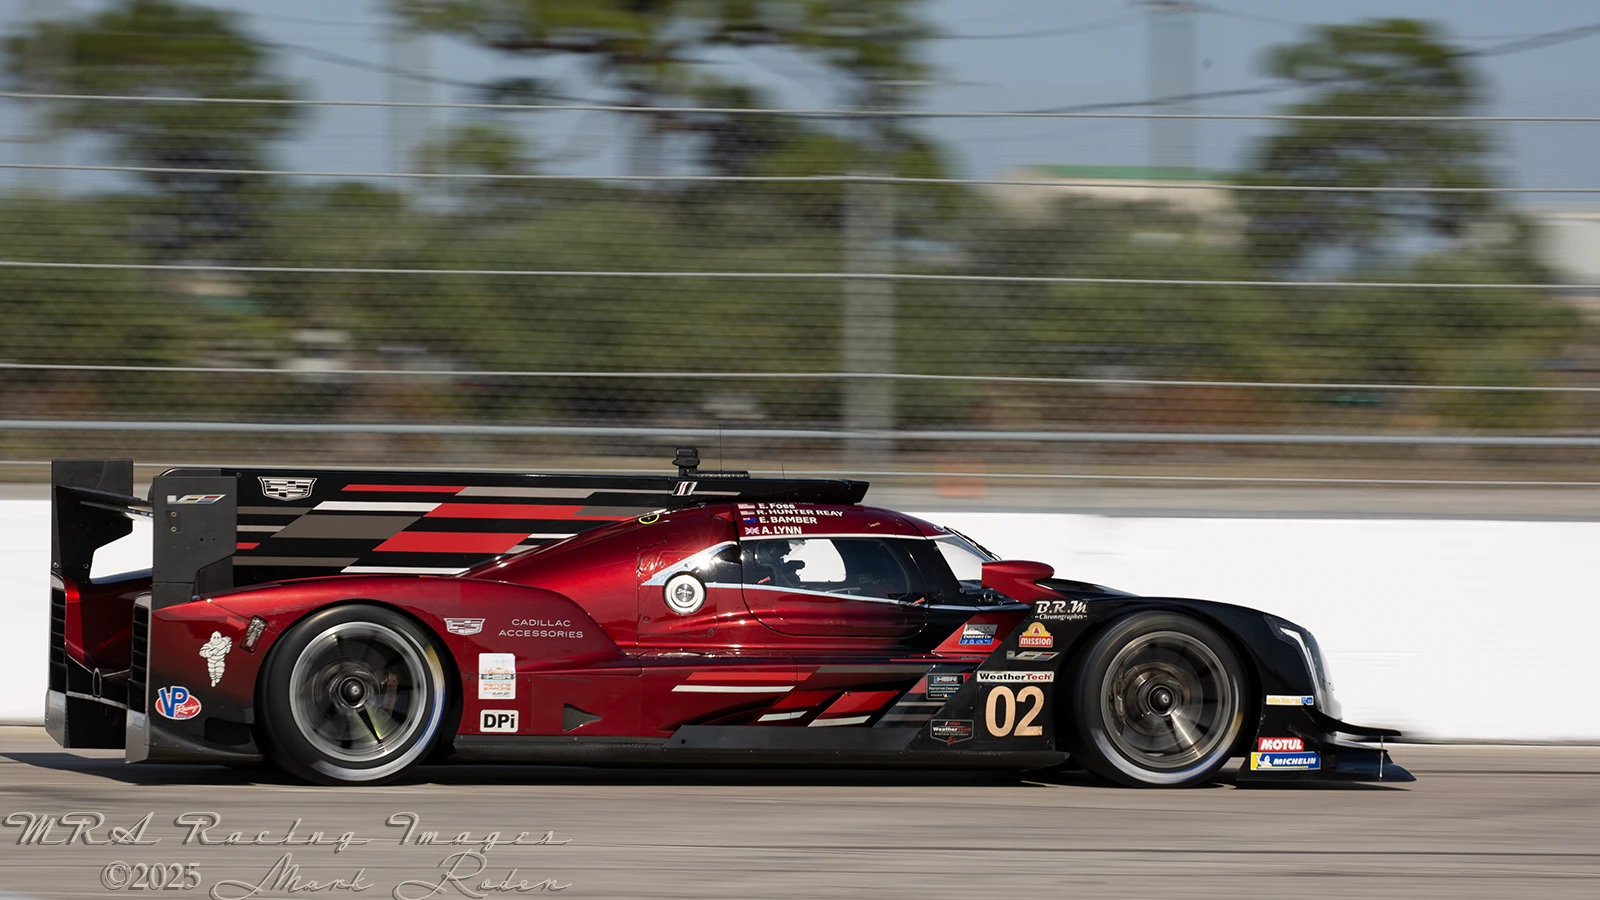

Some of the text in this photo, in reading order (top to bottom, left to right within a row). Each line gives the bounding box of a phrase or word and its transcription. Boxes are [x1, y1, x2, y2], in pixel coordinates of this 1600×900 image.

[815, 509, 843, 517] REAY
[759, 516, 818, 525] E. BAMBER
[761, 526, 802, 535] A. LYNN
[511, 618, 571, 627] CADILLAC
[498, 629, 584, 639] ACCESSORIES
[1020, 637, 1051, 646] MISSION
[979, 673, 1052, 681] WeatherTech
[158, 686, 190, 719] VP
[985, 685, 1045, 737] 02
[483, 713, 516, 729] DPi
[1260, 739, 1303, 751] MOTUL
[1272, 757, 1317, 766] MICHELIN
